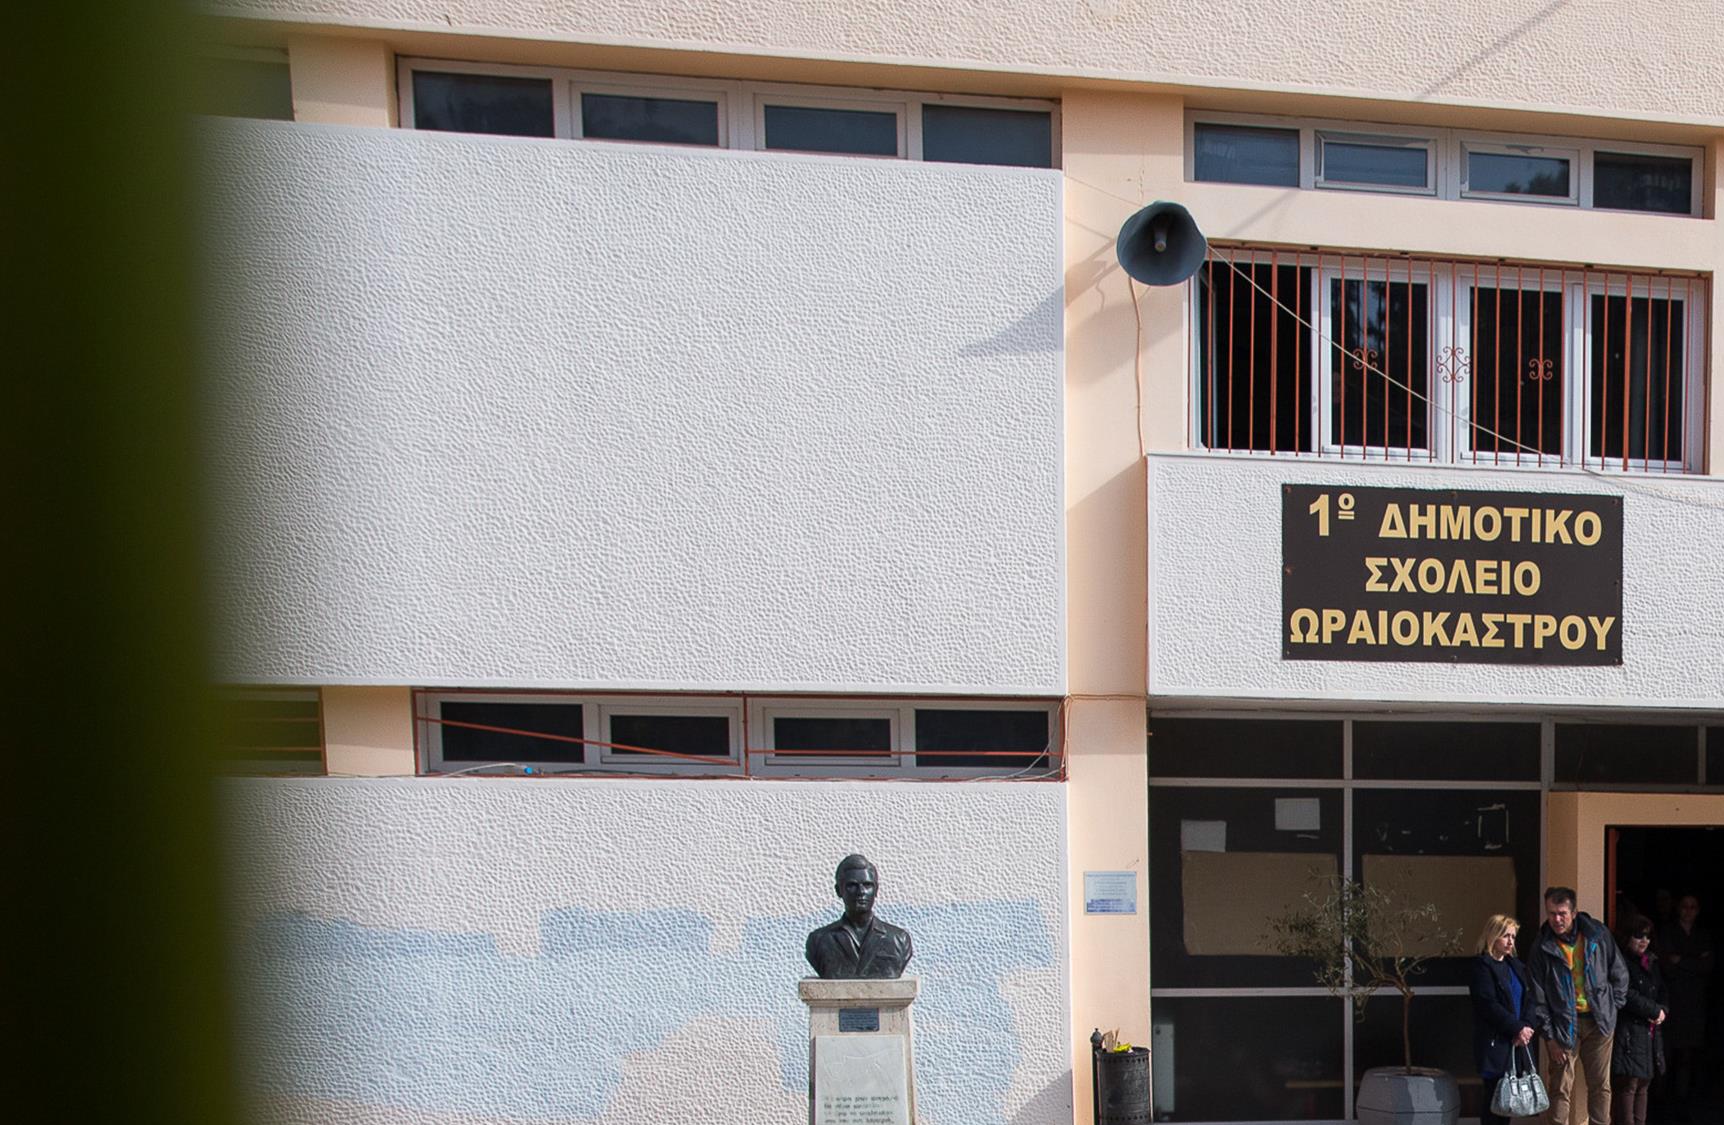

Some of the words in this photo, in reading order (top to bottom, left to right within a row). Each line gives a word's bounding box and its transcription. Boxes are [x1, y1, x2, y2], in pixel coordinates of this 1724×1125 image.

[1378, 502, 1602, 547] ΔΗΜΟΤΙΚΟ
[1364, 556, 1542, 597] ΣΧΟΛΕΙΟ
[1289, 607, 1616, 651] ΩΡΑΙΟΚΑΣΤΡΟΥ
